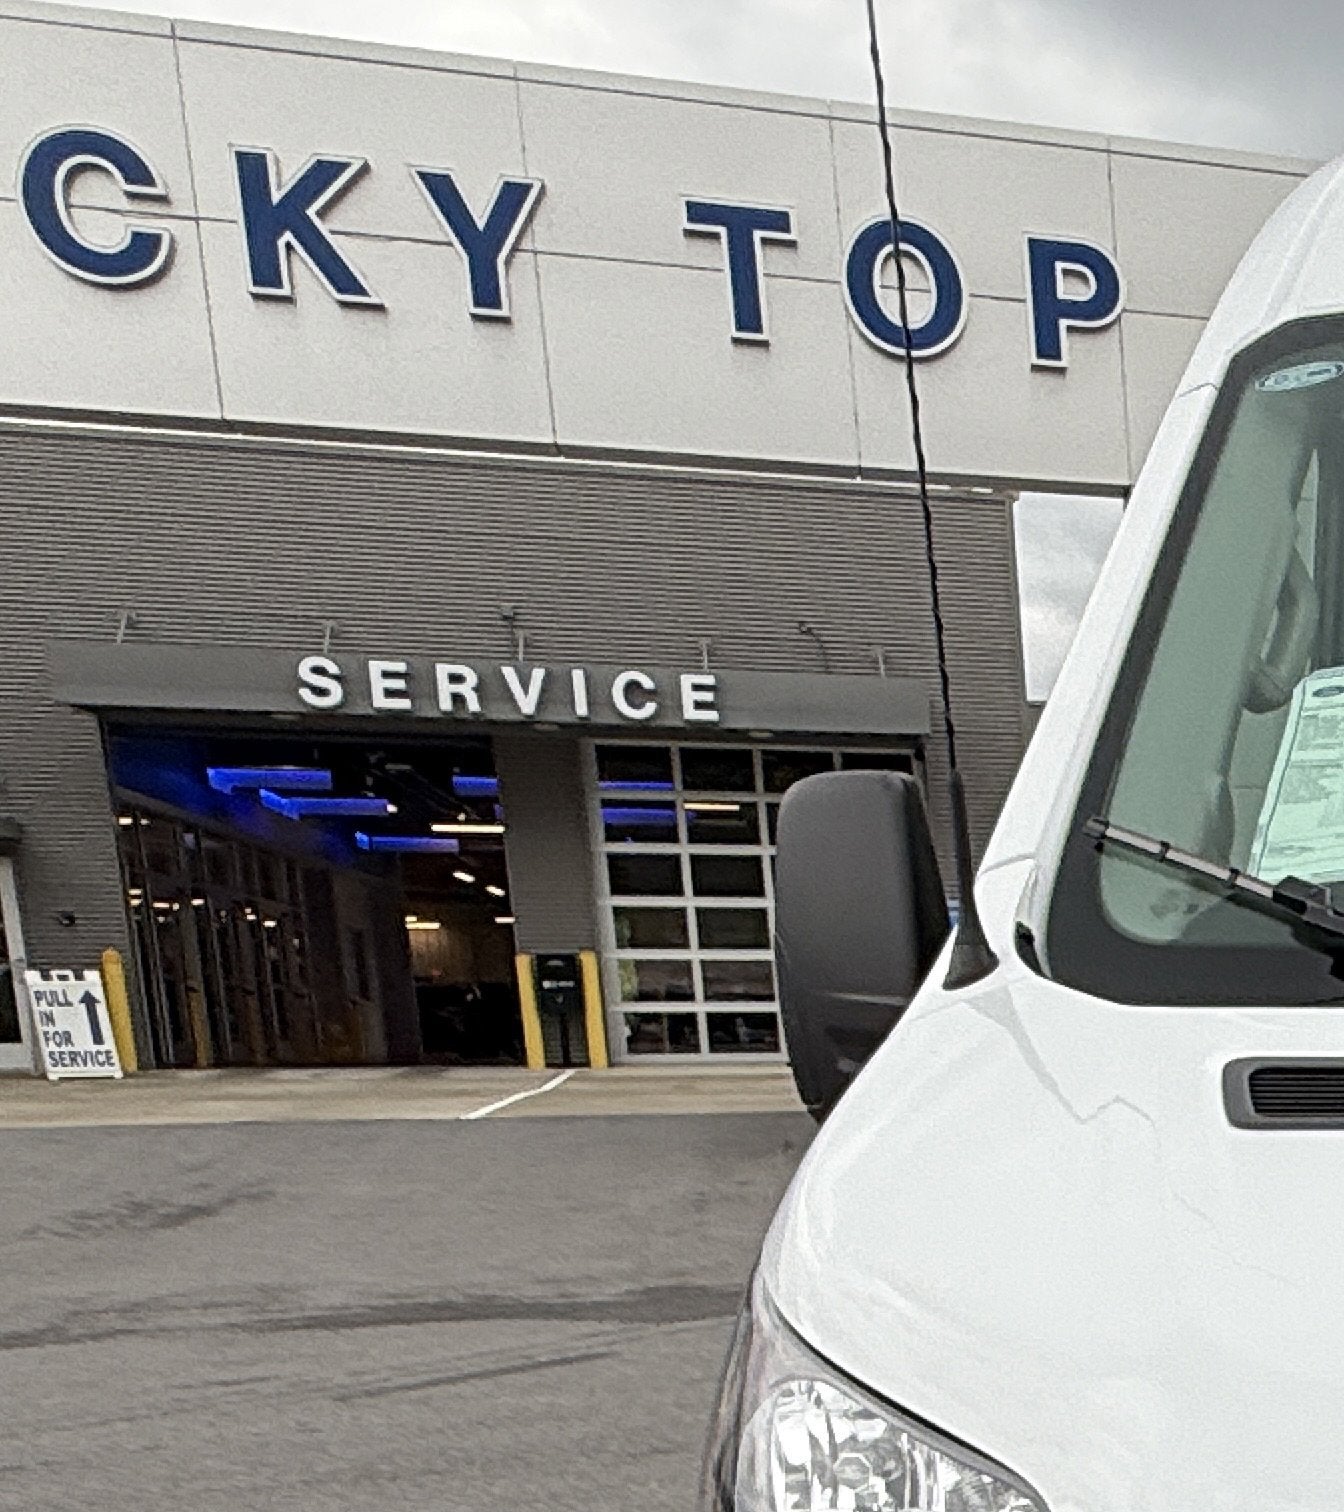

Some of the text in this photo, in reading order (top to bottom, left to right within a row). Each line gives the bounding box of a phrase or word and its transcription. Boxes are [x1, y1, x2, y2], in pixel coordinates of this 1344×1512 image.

[20, 124, 1124, 368] CKY TOP
[298, 656, 721, 722] SERVICE
[33, 989, 73, 1007] PULL
[39, 1010, 55, 1027] IN
[42, 1030, 74, 1047] FOR
[48, 1050, 115, 1067] SERVICE
